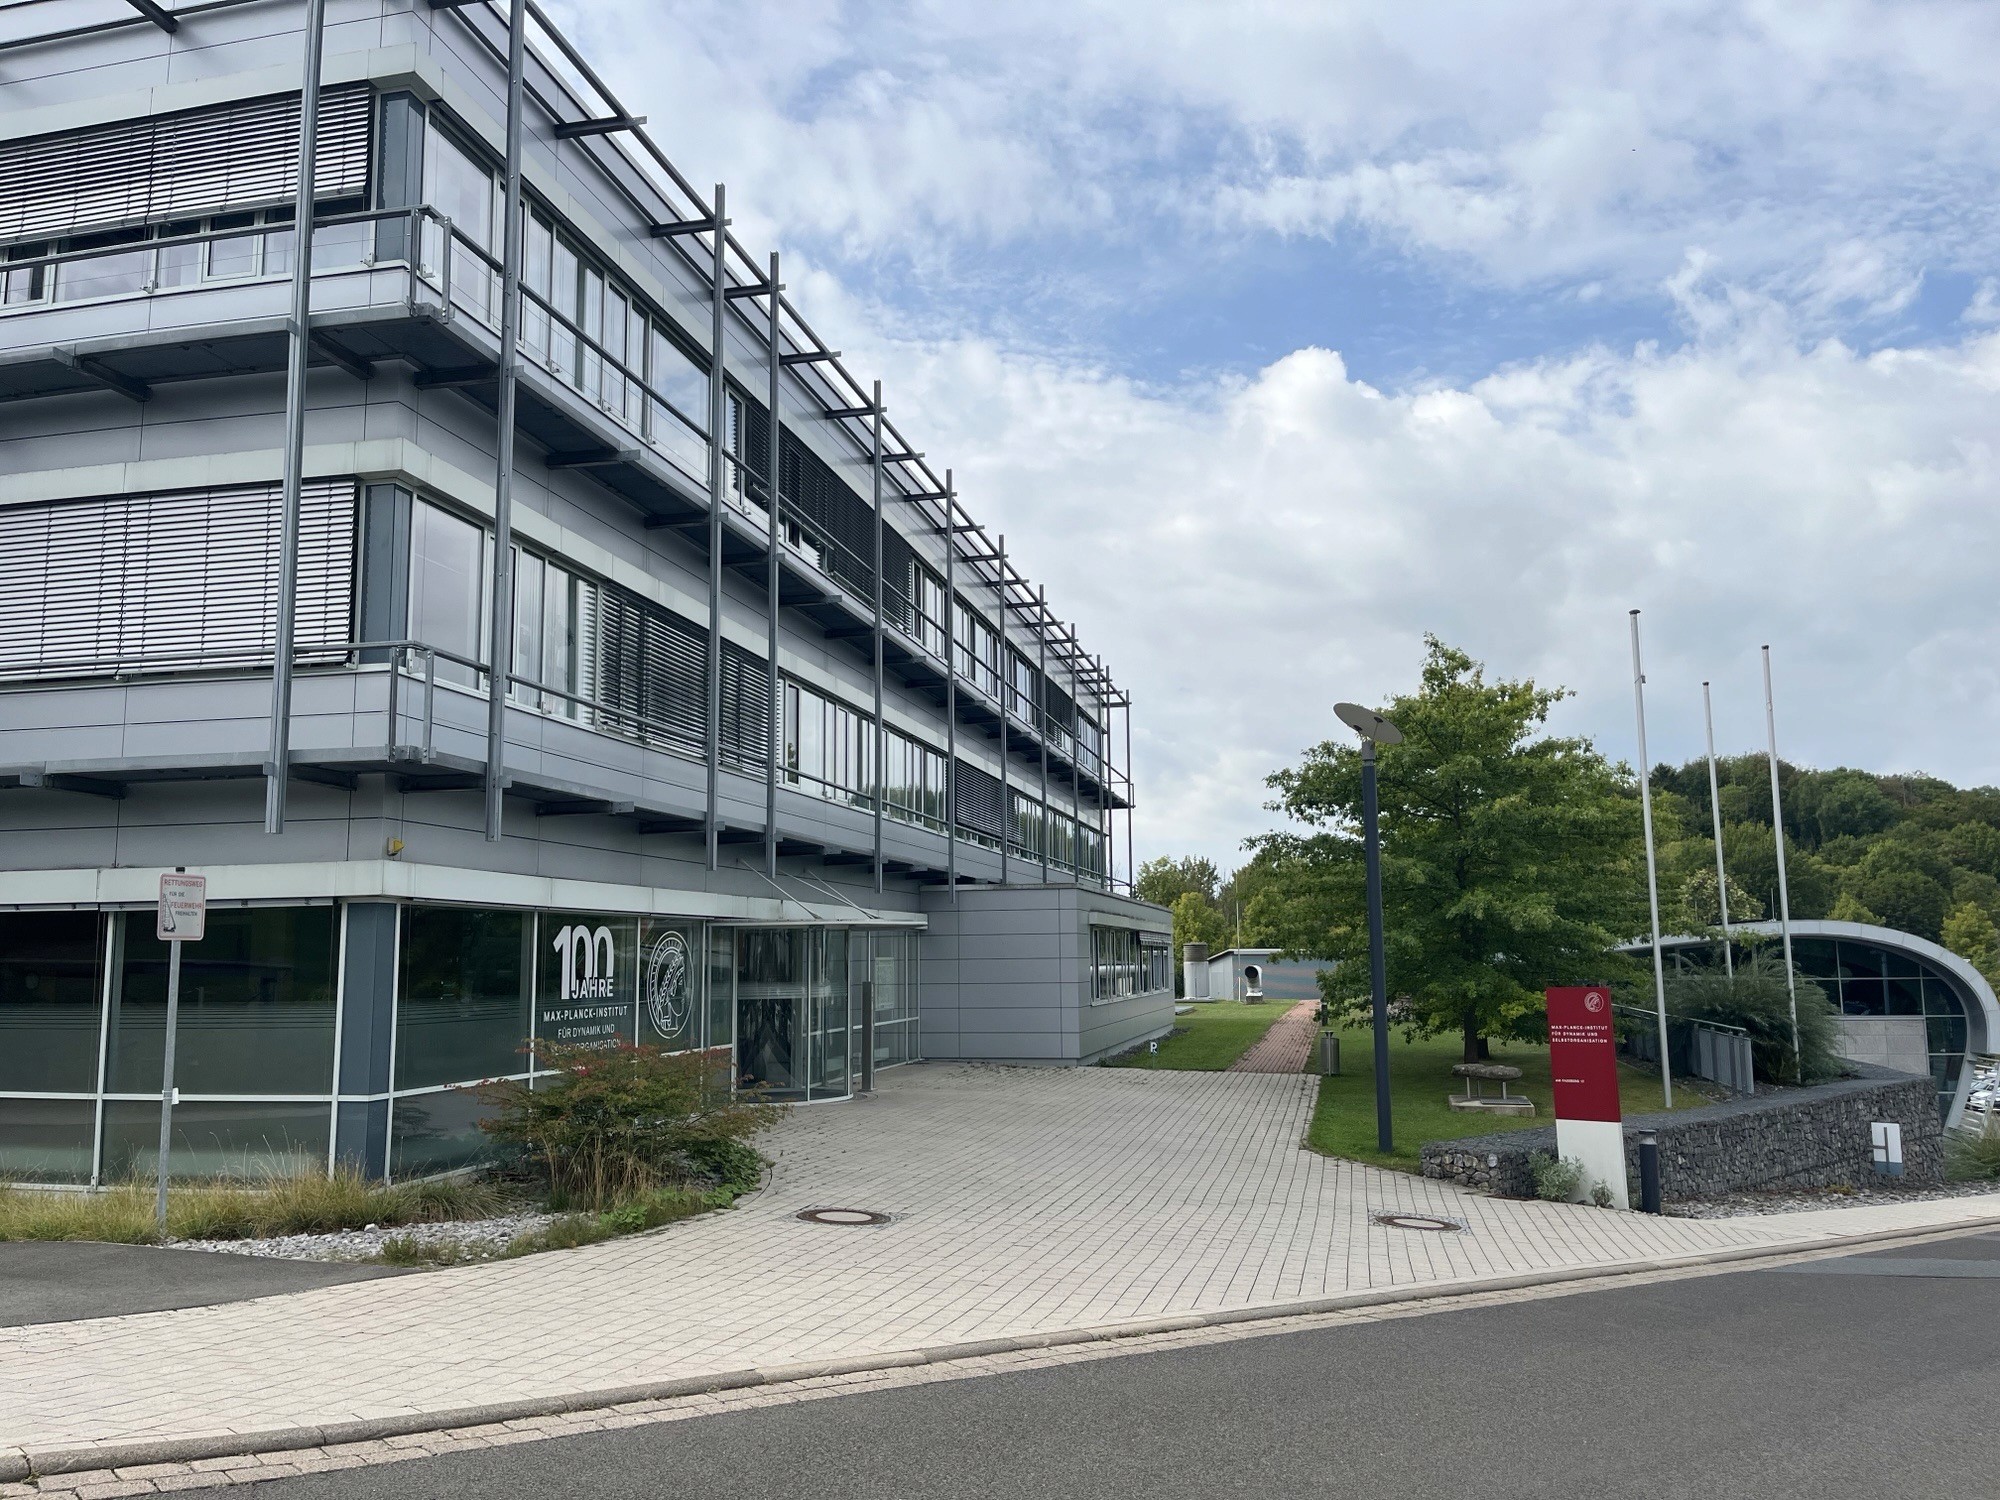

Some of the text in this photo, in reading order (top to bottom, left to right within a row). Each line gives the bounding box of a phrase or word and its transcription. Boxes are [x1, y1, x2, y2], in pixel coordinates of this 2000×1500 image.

[164, 879, 203, 887] RETTUNGSWEG
[552, 924, 615, 1000] 100
[571, 978, 614, 999] JAHRE
[543, 1005, 628, 1022] MAX-PLANCK-INSTITUT
[557, 1023, 615, 1039] FÜR DYNAMIK UND
